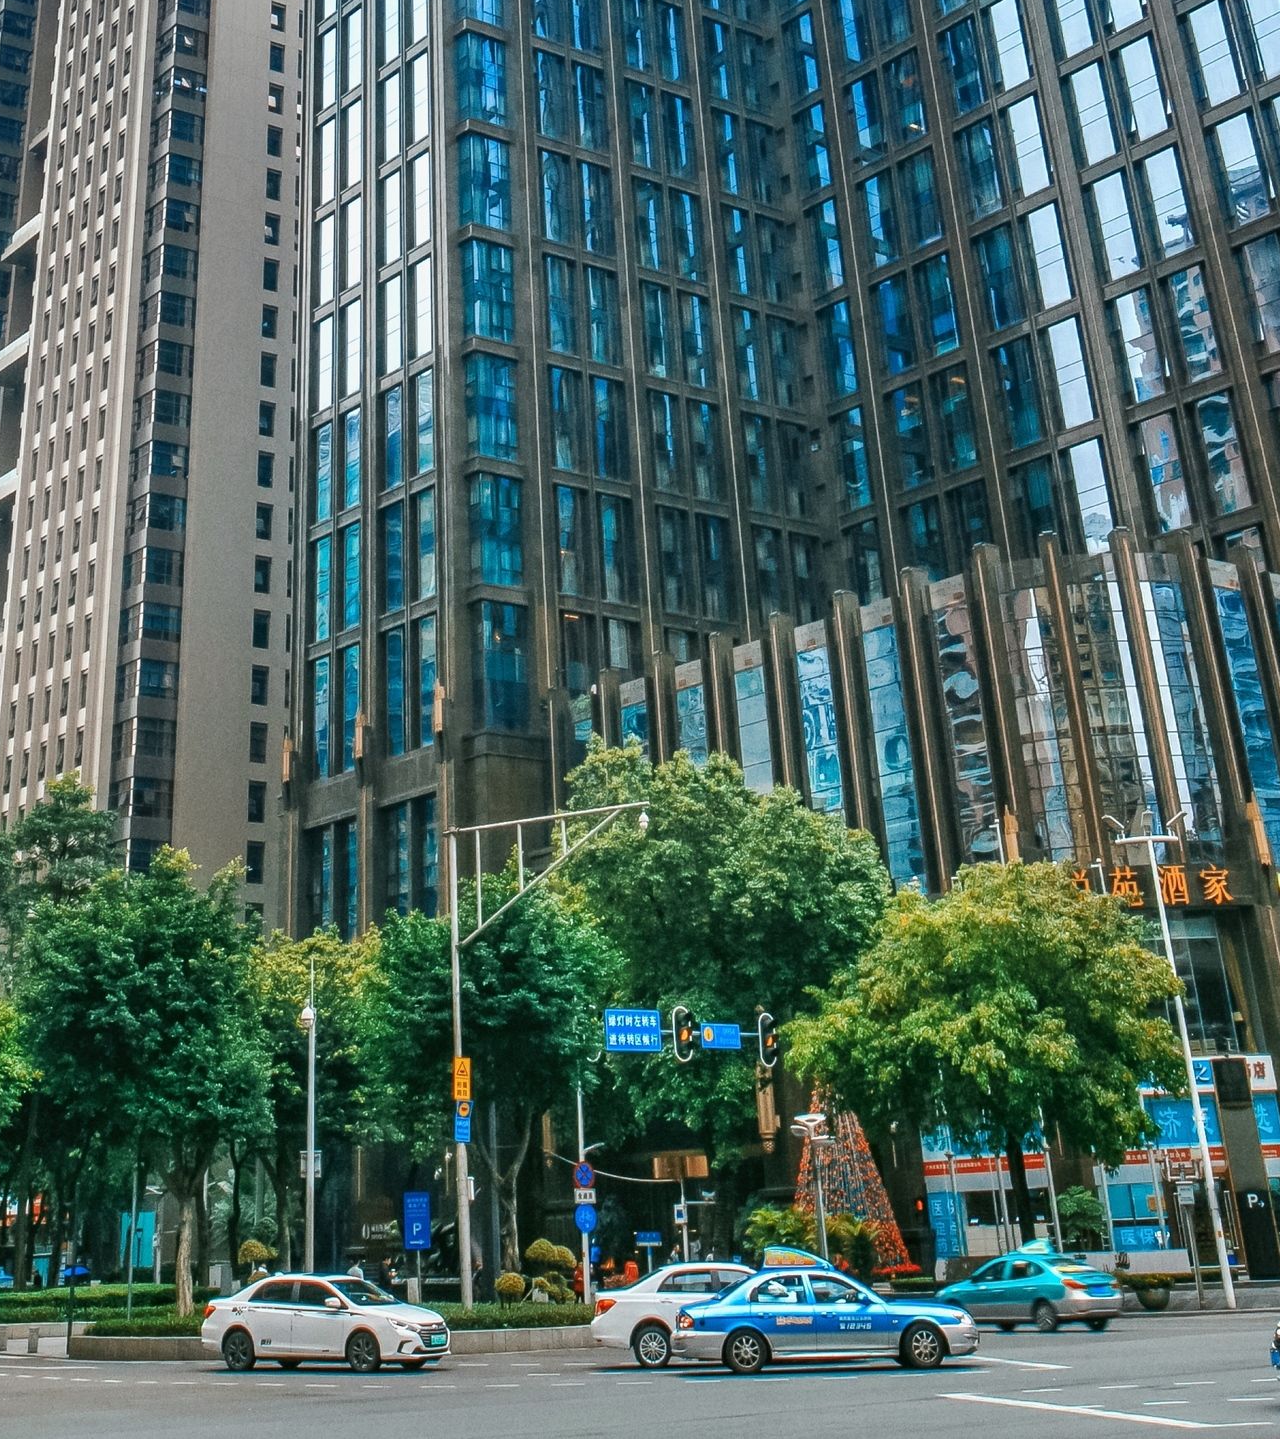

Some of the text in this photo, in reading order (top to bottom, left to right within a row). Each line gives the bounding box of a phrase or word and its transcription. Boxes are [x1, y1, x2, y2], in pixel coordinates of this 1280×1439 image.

[608, 1014, 657, 1027] 绿灯时左转车
[1247, 1194, 1259, 1208] P
[413, 1223, 422, 1236] P
[1120, 1229, 1155, 1245] 医保
